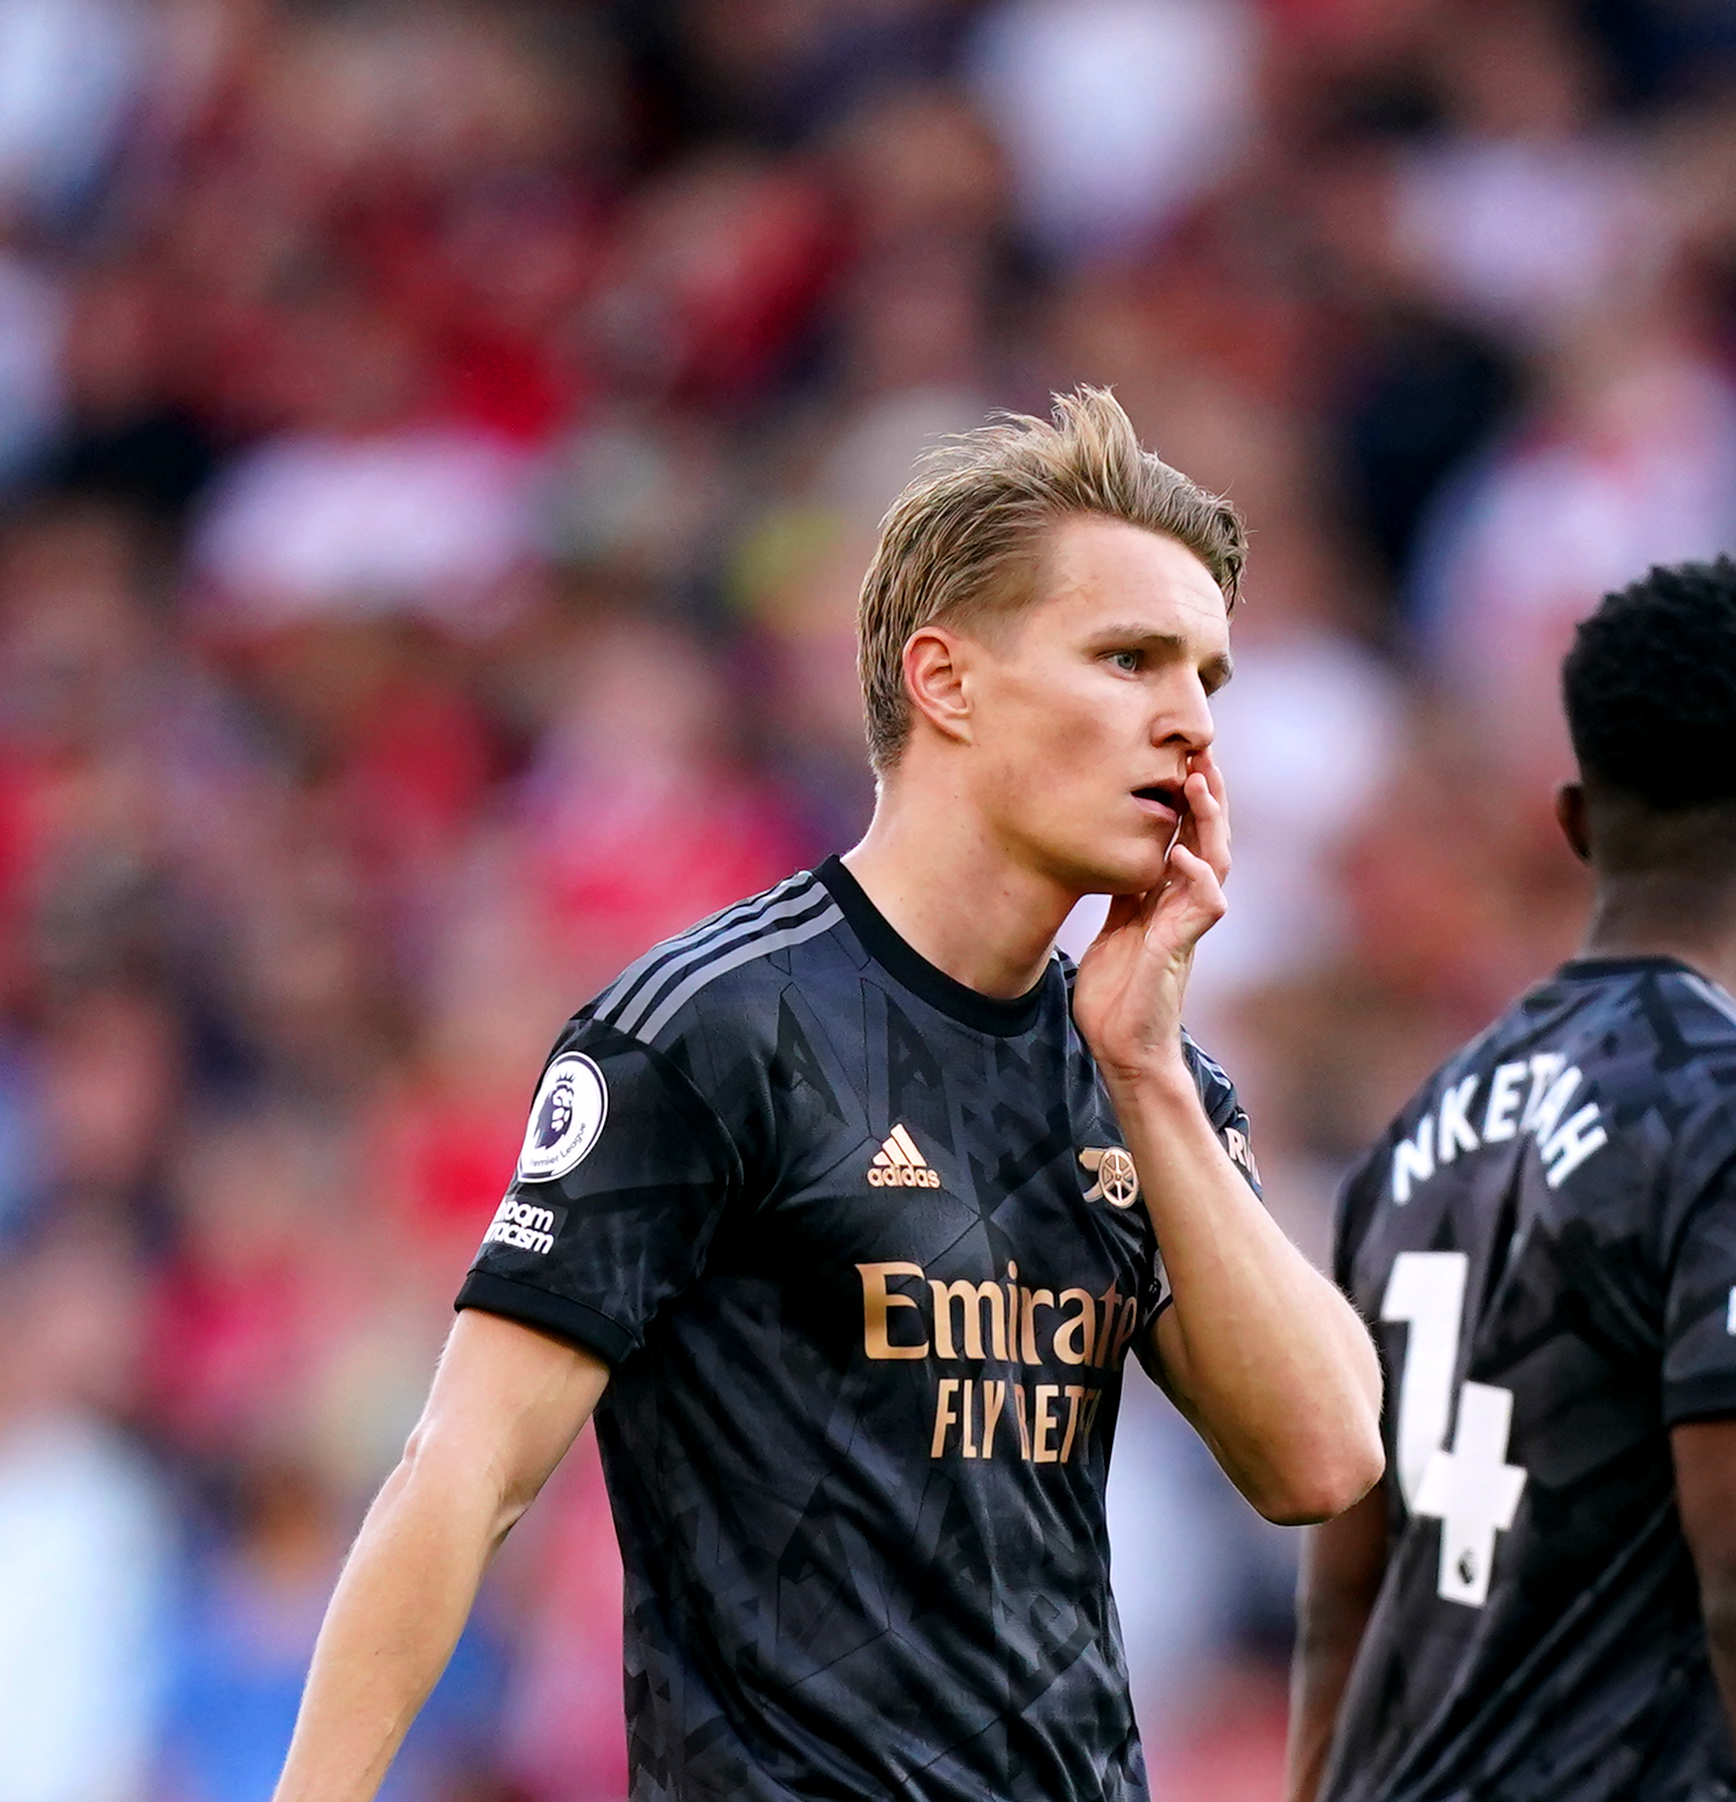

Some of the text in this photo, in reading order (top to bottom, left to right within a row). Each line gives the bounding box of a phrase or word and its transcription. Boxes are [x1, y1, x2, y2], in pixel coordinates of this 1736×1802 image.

[867, 1163, 941, 1189] adidas
[854, 1260, 1138, 1370] Emirate
[931, 1378, 1006, 1459] FLY
[1380, 1251, 1527, 1609] 14
